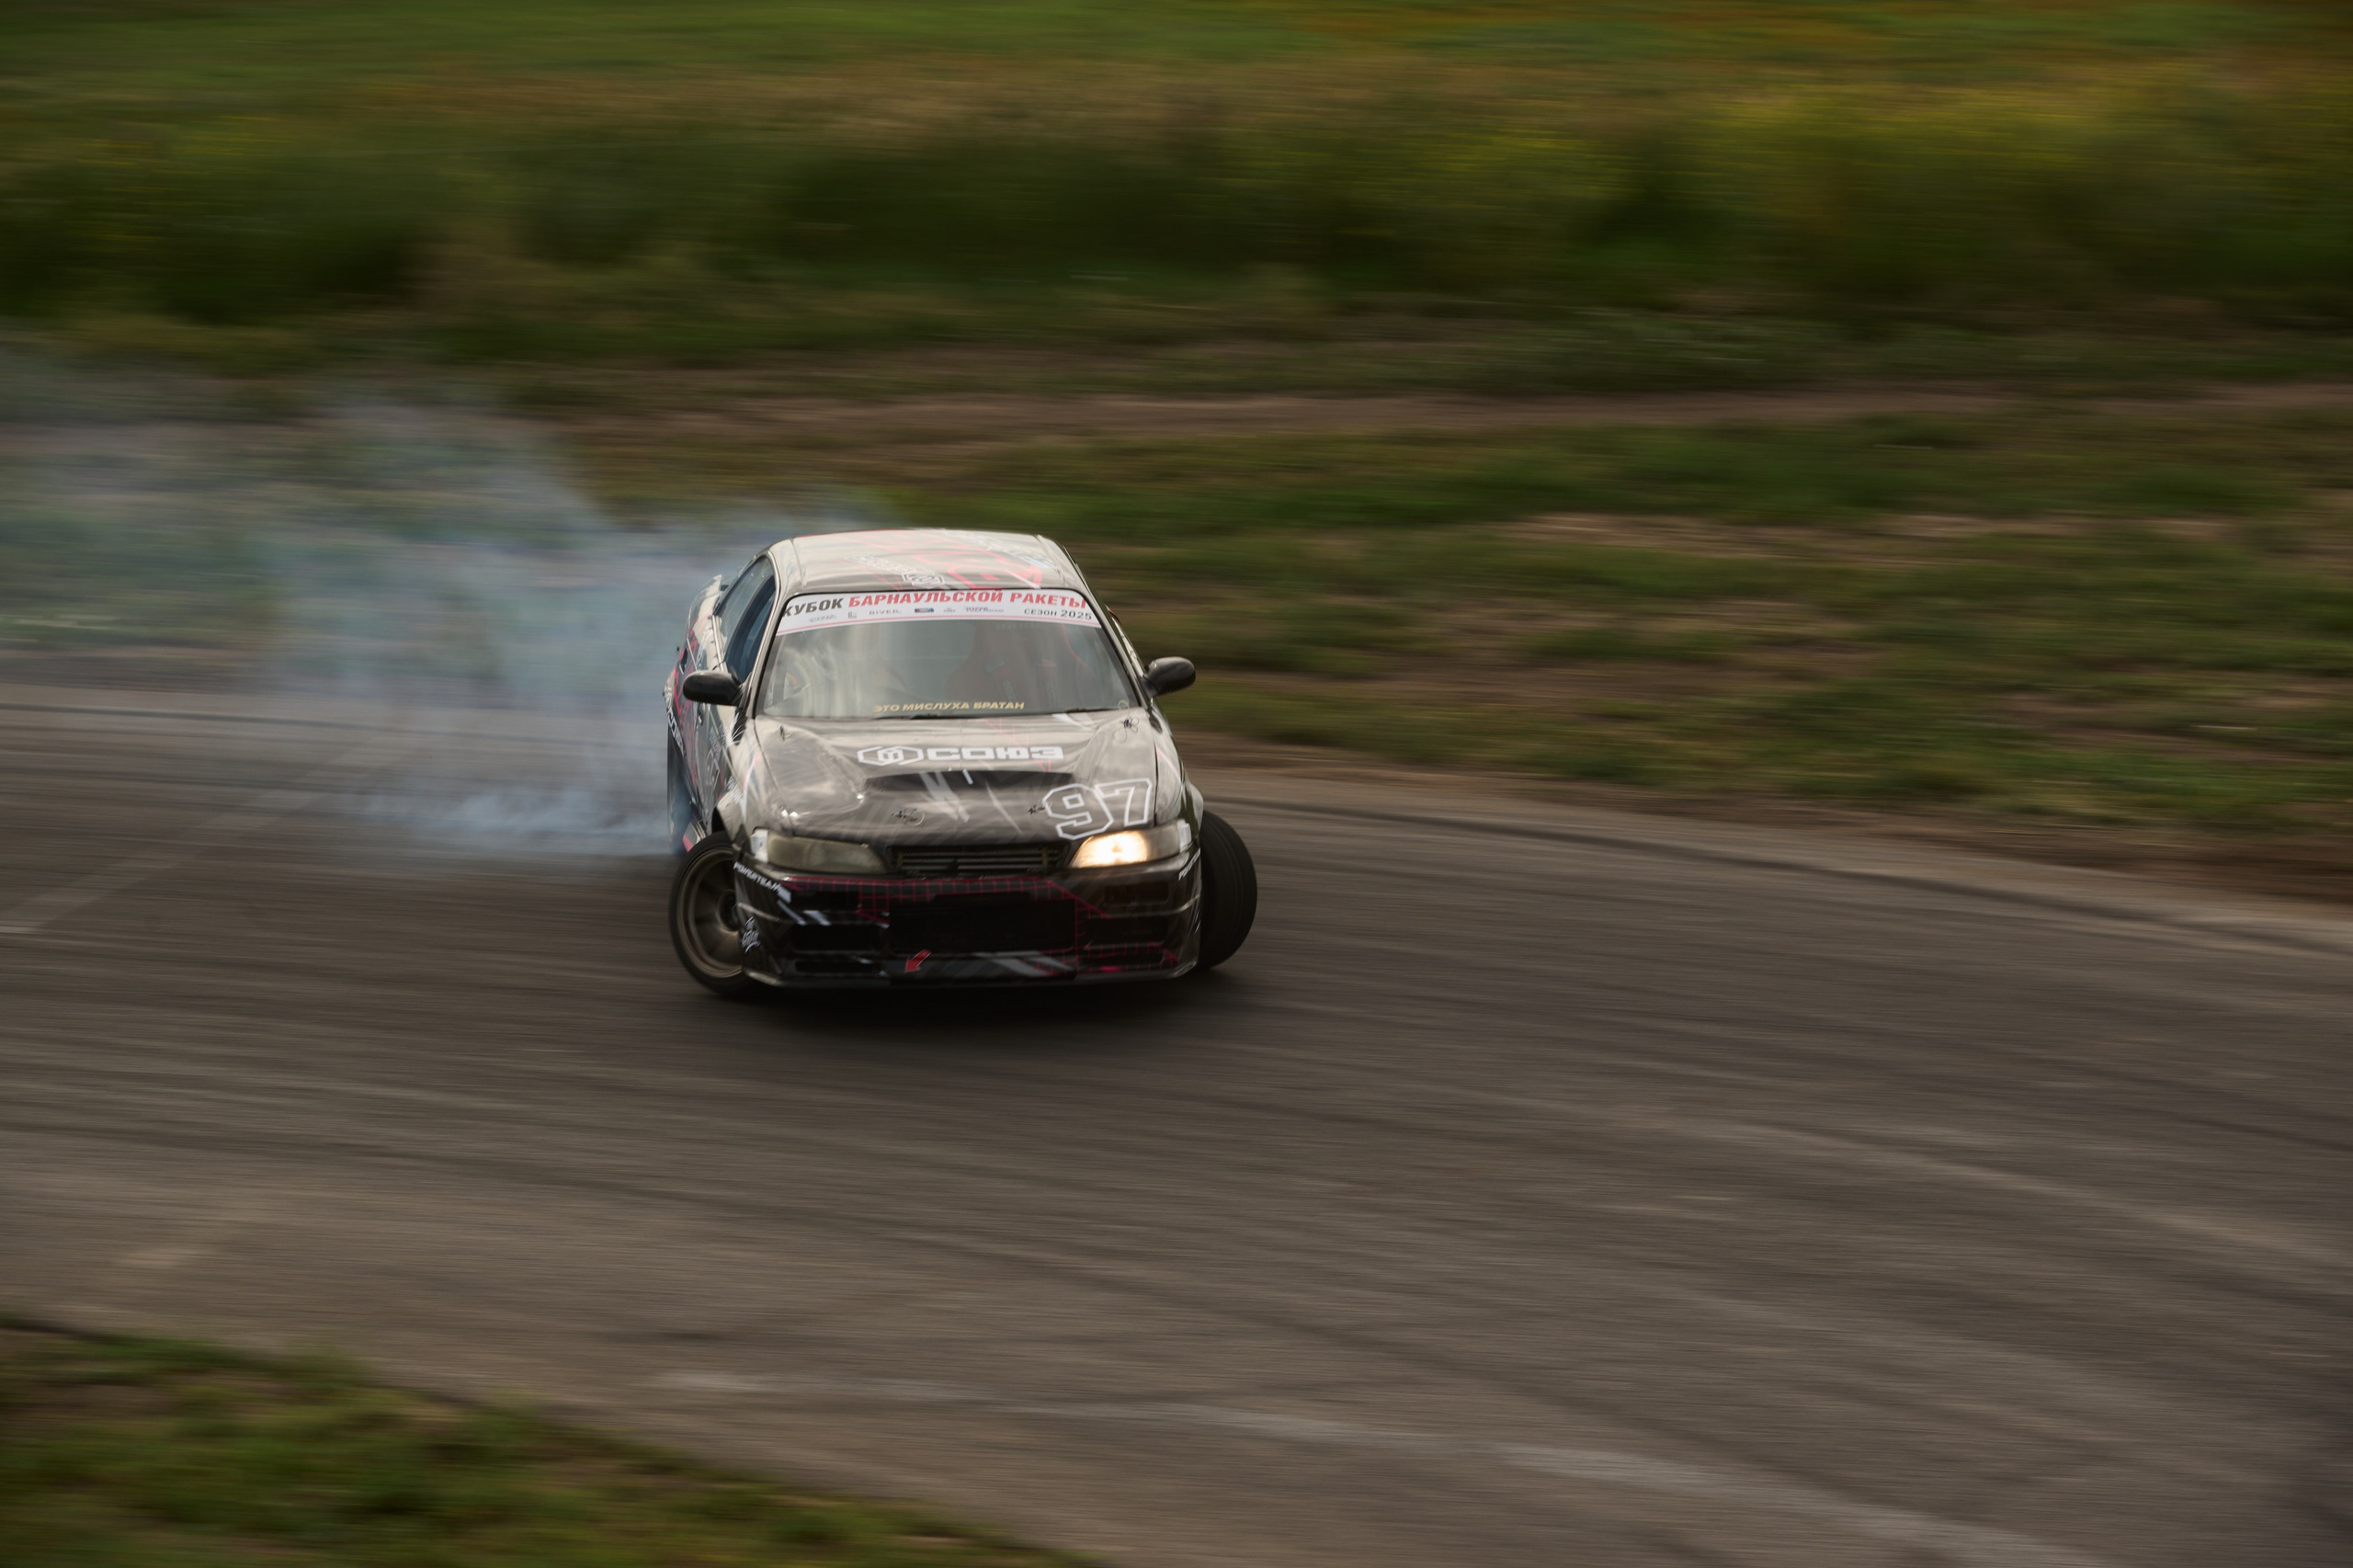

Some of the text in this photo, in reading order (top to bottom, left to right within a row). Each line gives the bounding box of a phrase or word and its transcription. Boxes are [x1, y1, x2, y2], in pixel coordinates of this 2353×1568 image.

[782, 597, 845, 618] КУБОК
[848, 589, 1004, 608] БАРНАУЛЬСКОЙ
[1009, 593, 1087, 609] РАКЕТЫ
[1024, 608, 1092, 620] СЕЗОН 2025
[902, 702, 970, 711] МИСЛУХА
[972, 701, 1025, 710] БРАТАН
[926, 746, 1063, 761] СОЮЗ
[1041, 778, 1153, 840] 97
